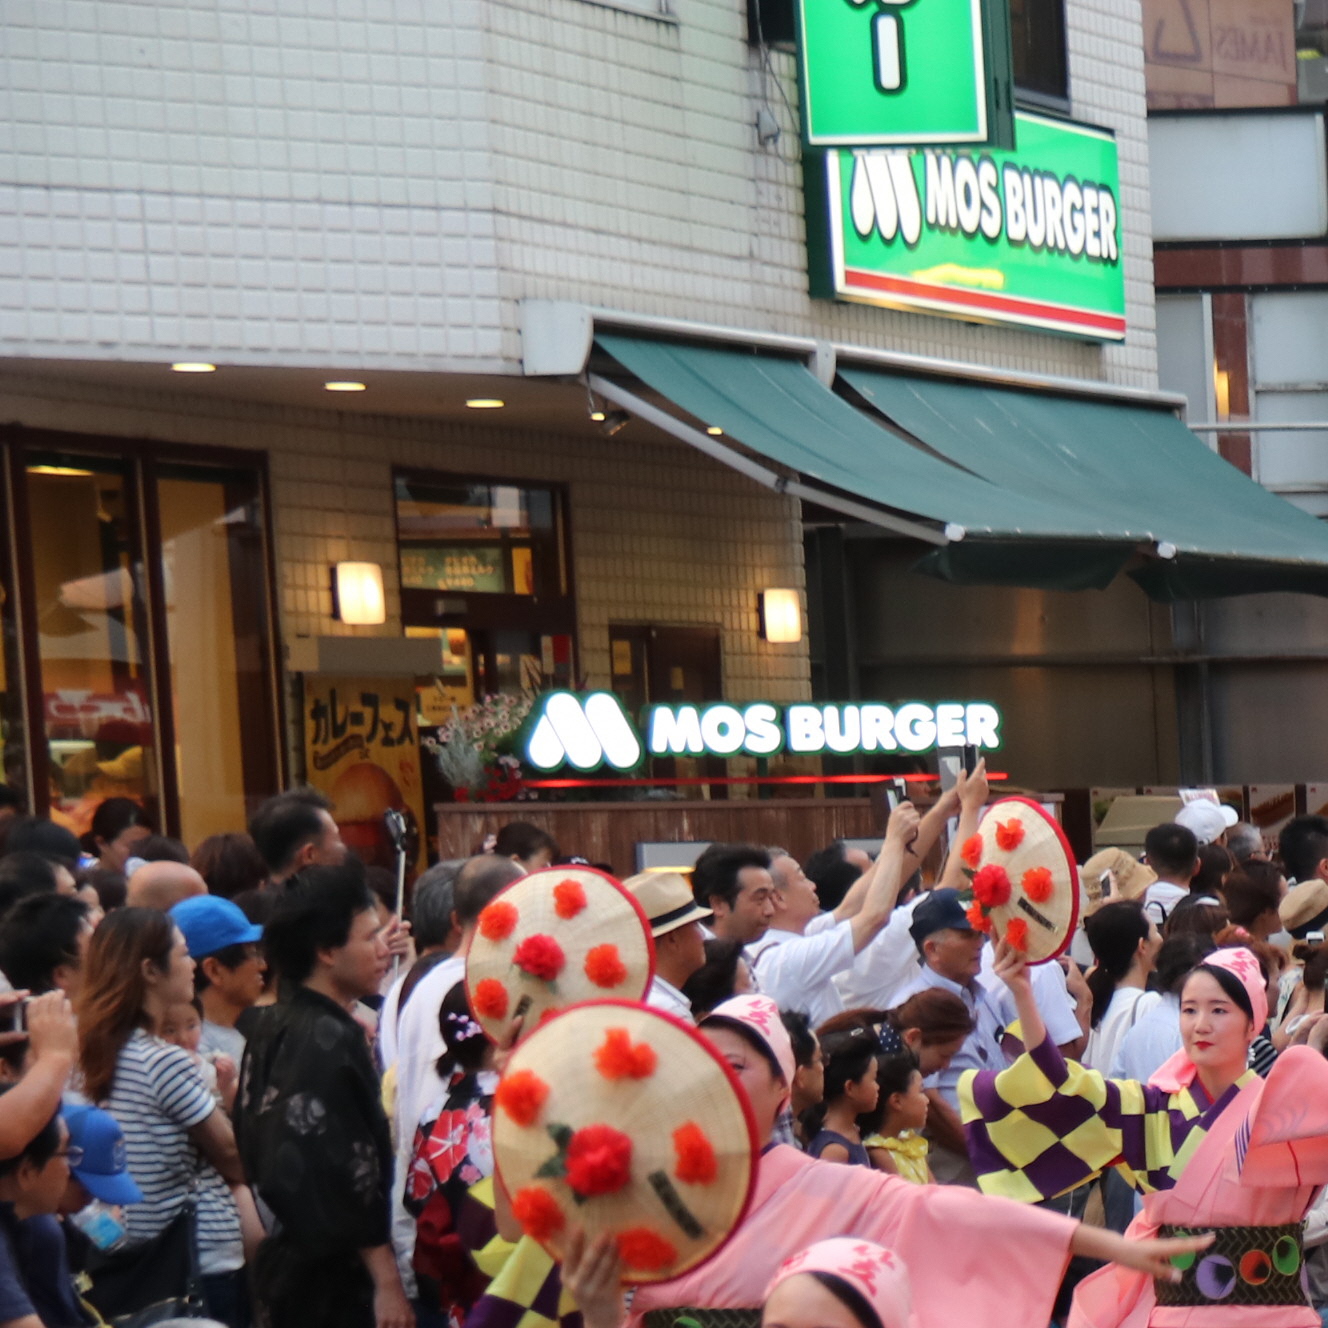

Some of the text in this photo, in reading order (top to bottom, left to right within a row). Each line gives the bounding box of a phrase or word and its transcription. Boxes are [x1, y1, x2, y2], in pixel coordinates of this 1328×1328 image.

[924, 152, 1002, 239] MOS
[1003, 165, 1118, 261] BURGER
[310, 688, 415, 748] カレーフェス
[650, 703, 782, 754] MOS
[788, 702, 1000, 753] BURGER
